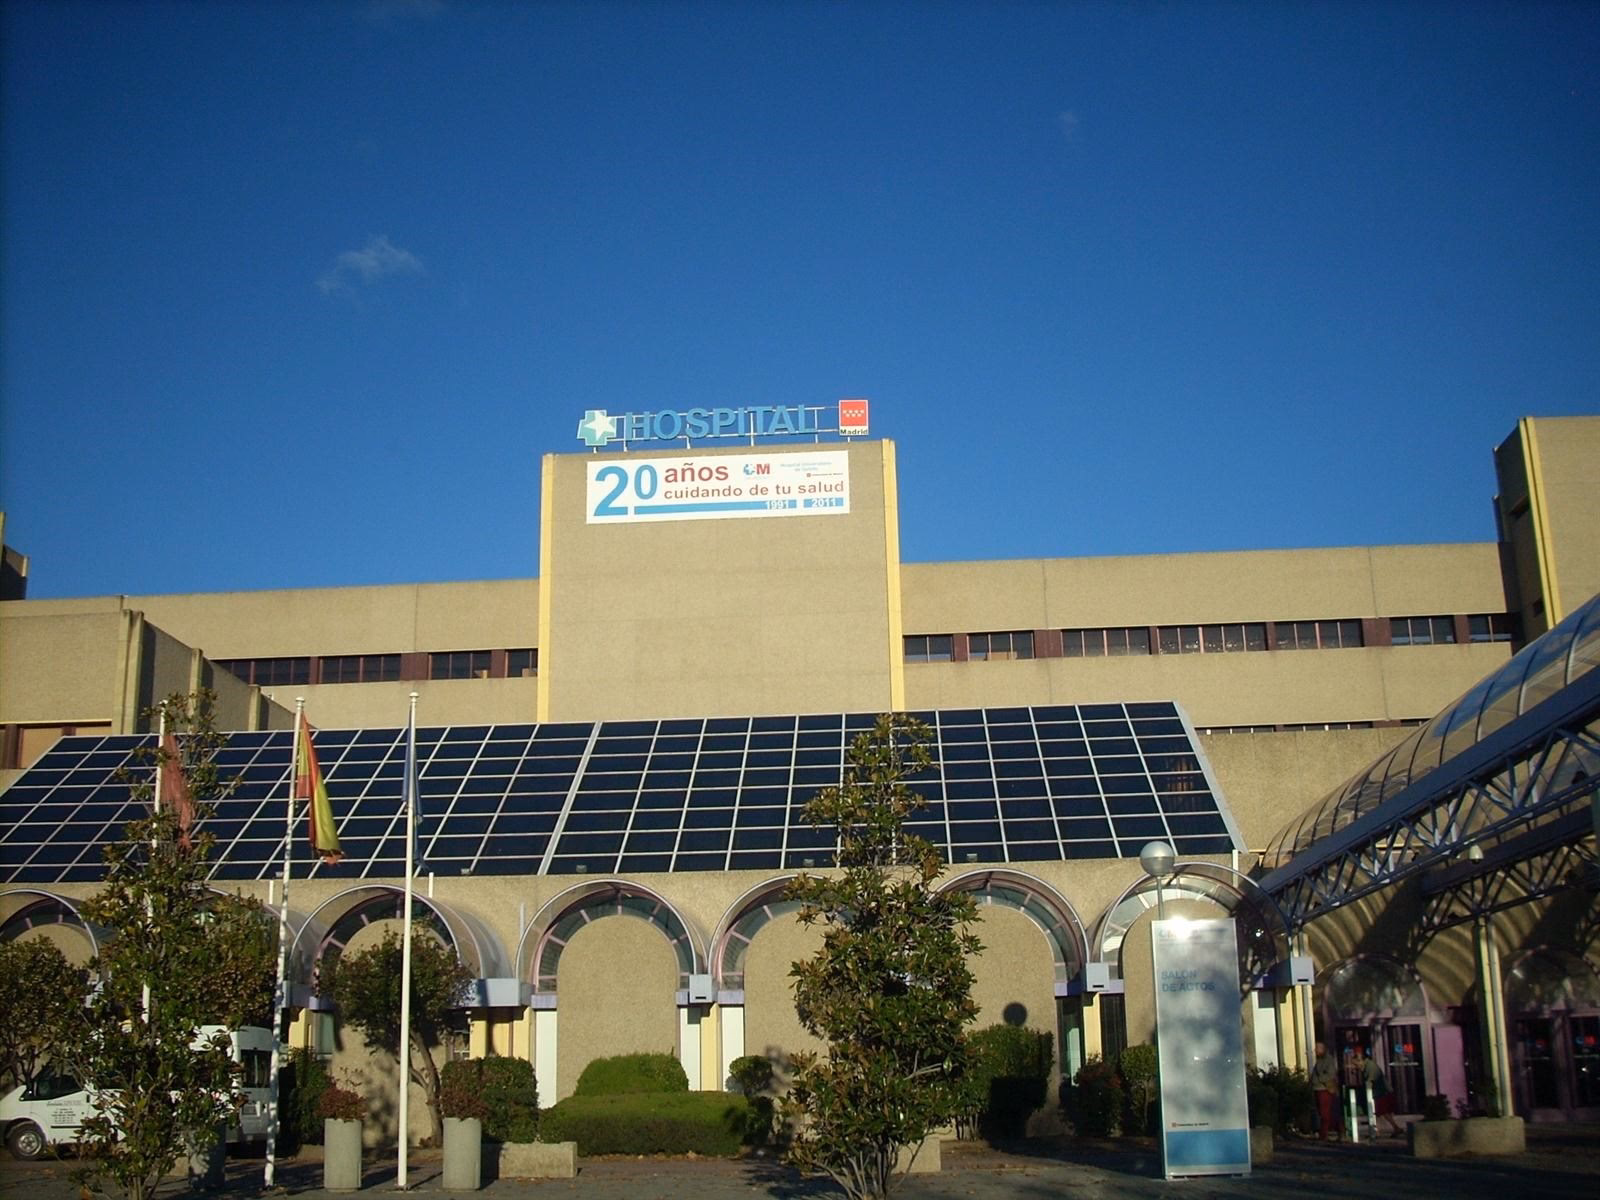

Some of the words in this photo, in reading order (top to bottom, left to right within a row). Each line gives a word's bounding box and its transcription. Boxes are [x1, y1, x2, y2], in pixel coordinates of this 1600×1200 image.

[624, 404, 818, 442] HOSPITAL
[839, 428, 869, 436] Madrid
[664, 462, 730, 484] años
[593, 464, 659, 517] 20
[663, 484, 743, 500] cuidando
[749, 484, 769, 496] de
[775, 483, 792, 495] tu
[797, 480, 845, 494] salud
[765, 500, 790, 511] 1991
[811, 497, 837, 508] 2011
[1161, 982, 1177, 993] DE
[1179, 981, 1217, 993] ACTOS
